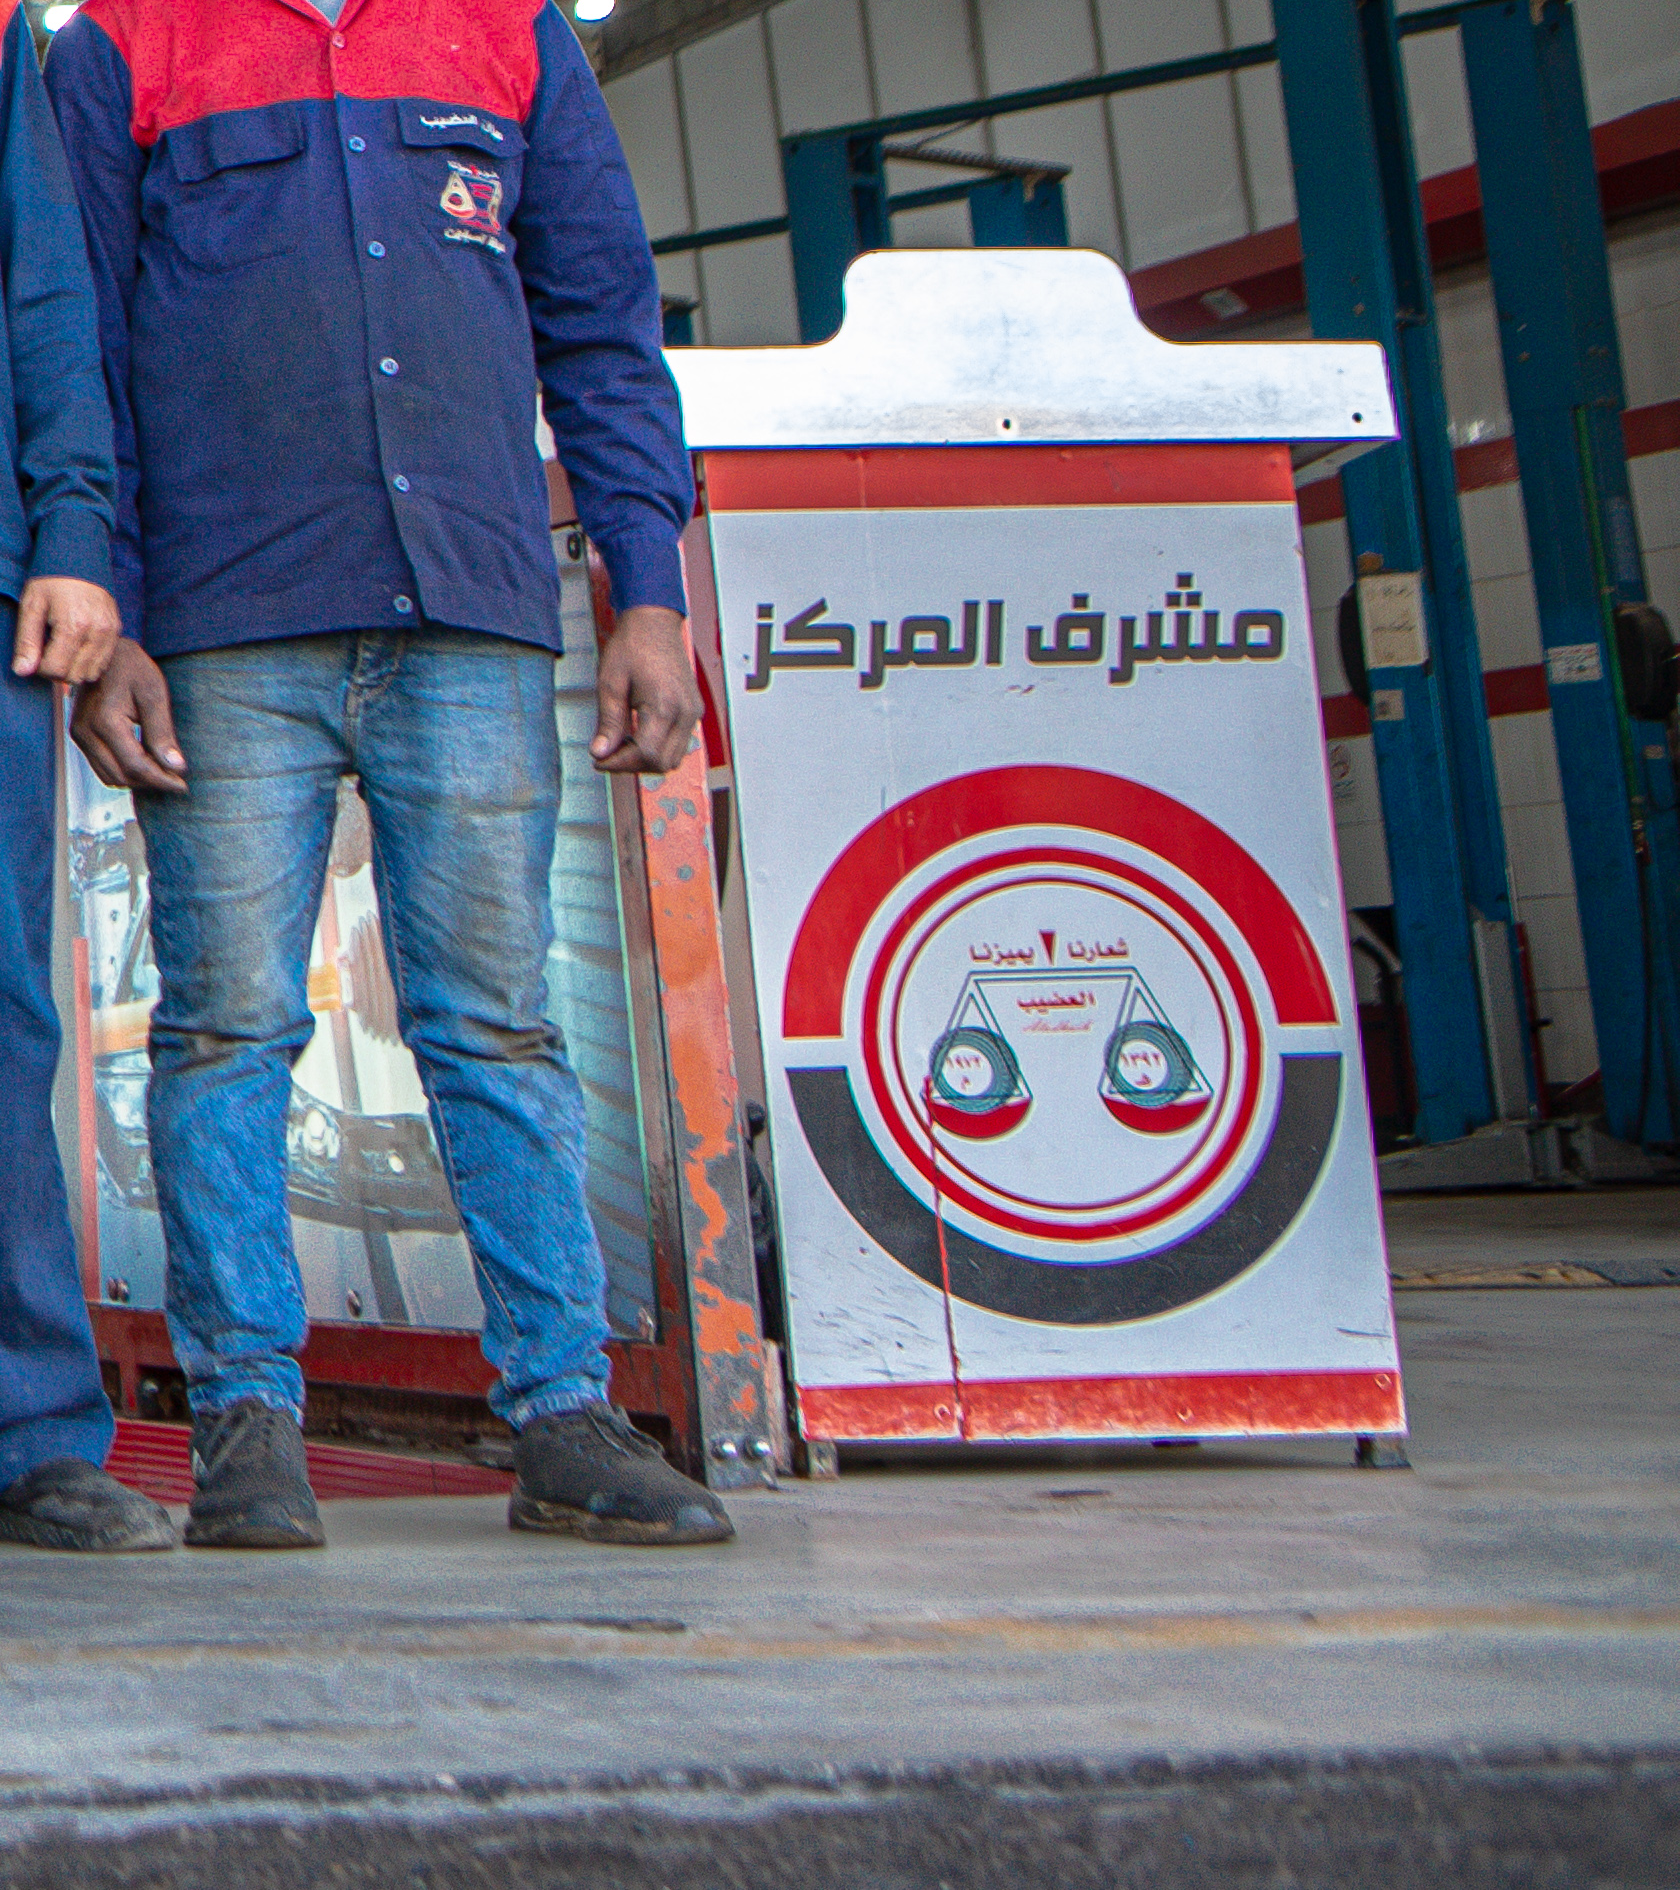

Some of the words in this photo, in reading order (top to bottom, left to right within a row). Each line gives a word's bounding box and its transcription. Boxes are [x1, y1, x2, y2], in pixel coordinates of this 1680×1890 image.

[1024, 571, 1287, 688] مشرف
[744, 597, 1006, 692] المركز
[968, 942, 1035, 966] يميزنا
[1066, 937, 1130, 964] شعارنا
[1016, 991, 1096, 1016] العضيب
